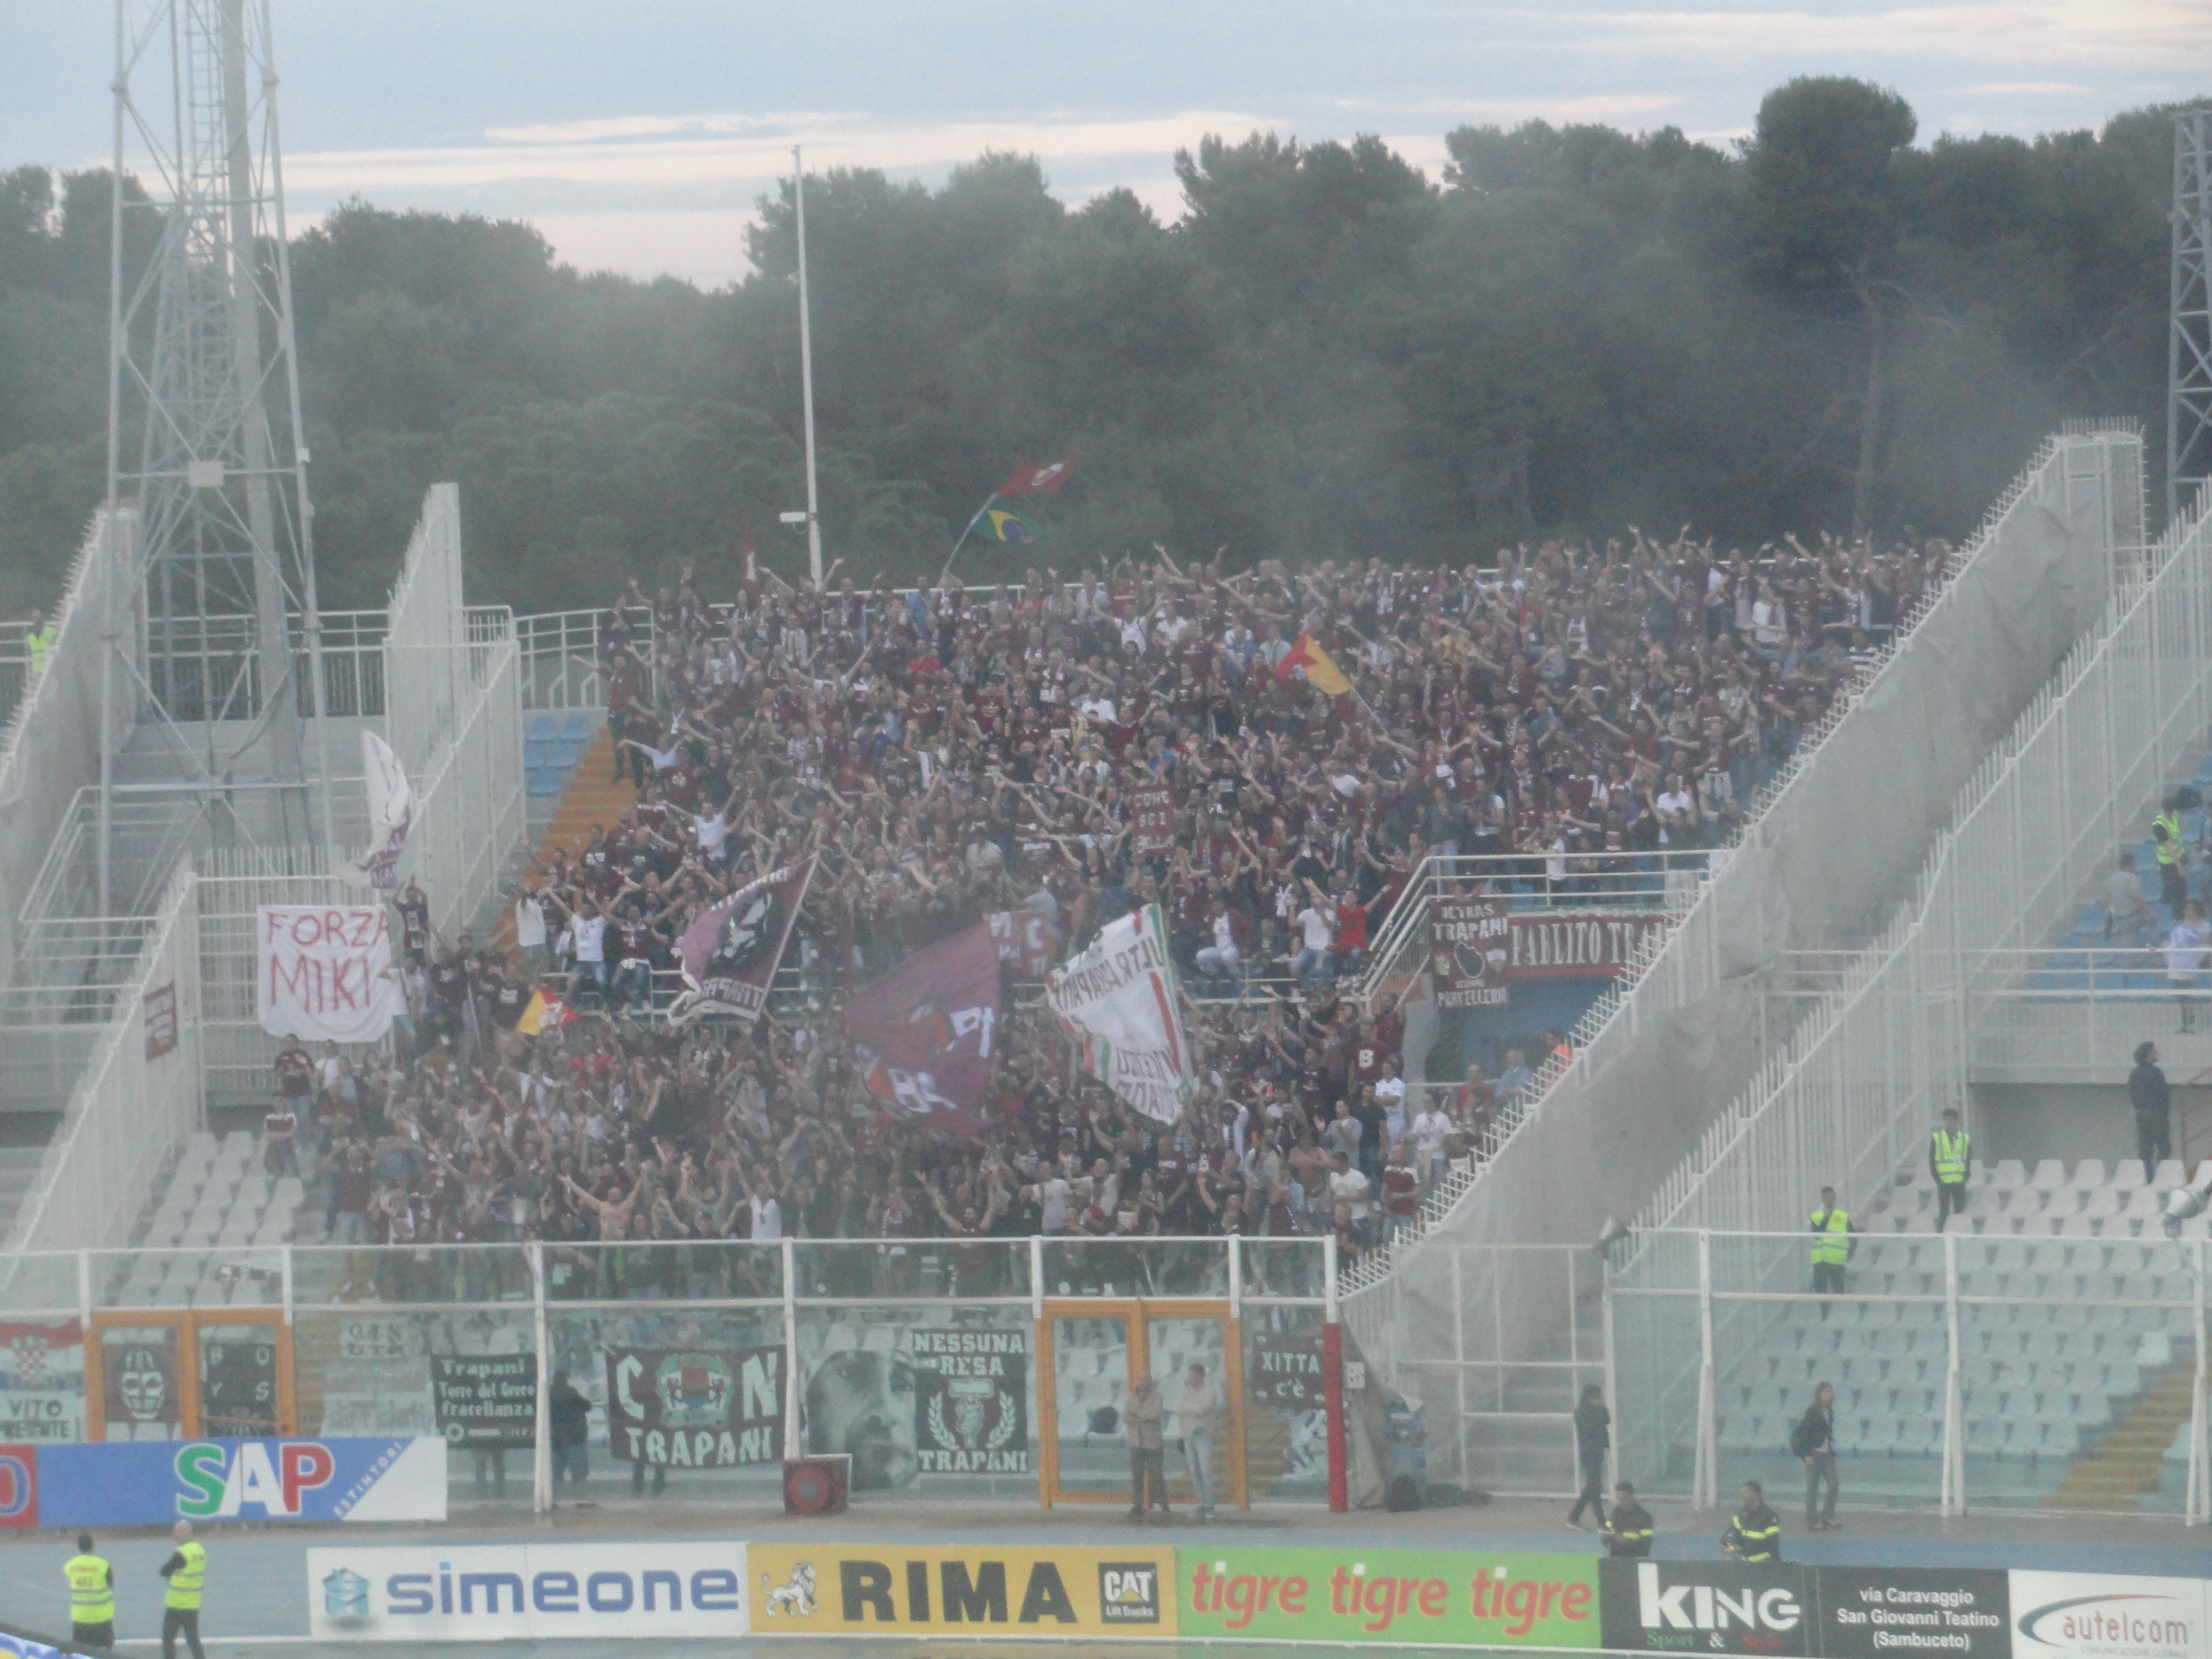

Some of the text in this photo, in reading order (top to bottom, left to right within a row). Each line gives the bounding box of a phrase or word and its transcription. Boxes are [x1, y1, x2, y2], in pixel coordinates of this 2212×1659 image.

[266, 909, 392, 947] FORZA
[1433, 917, 1508, 941] TRAPANI
[269, 953, 370, 1013] MIKI
[913, 1333, 1025, 1353] NESSUNA
[440, 1357, 525, 1379] Trapani
[939, 1355, 1004, 1375] RESA
[1262, 1352, 1321, 1374] XITTA
[10, 1400, 62, 1417] VITO
[625, 1425, 773, 1466] TRAPANI
[918, 1449, 1027, 1472] TRAPANI
[175, 1441, 335, 1518] SAP
[386, 1561, 739, 1615] simeone
[839, 1560, 1078, 1624] RIMA
[1104, 1570, 1152, 1602] CAT
[1191, 1560, 1309, 1629] tigre
[1330, 1562, 1449, 1633] tigre
[1859, 1587, 1974, 1607] via Caravaggio
[1471, 1566, 1592, 1637] tigre
[1837, 1608, 2001, 1627] San Giovanni Teatino
[2062, 1610, 2189, 1645] autelcom
[1709, 1631, 1725, 1649] &
[1873, 1630, 1971, 1652] (Sambuceto)
